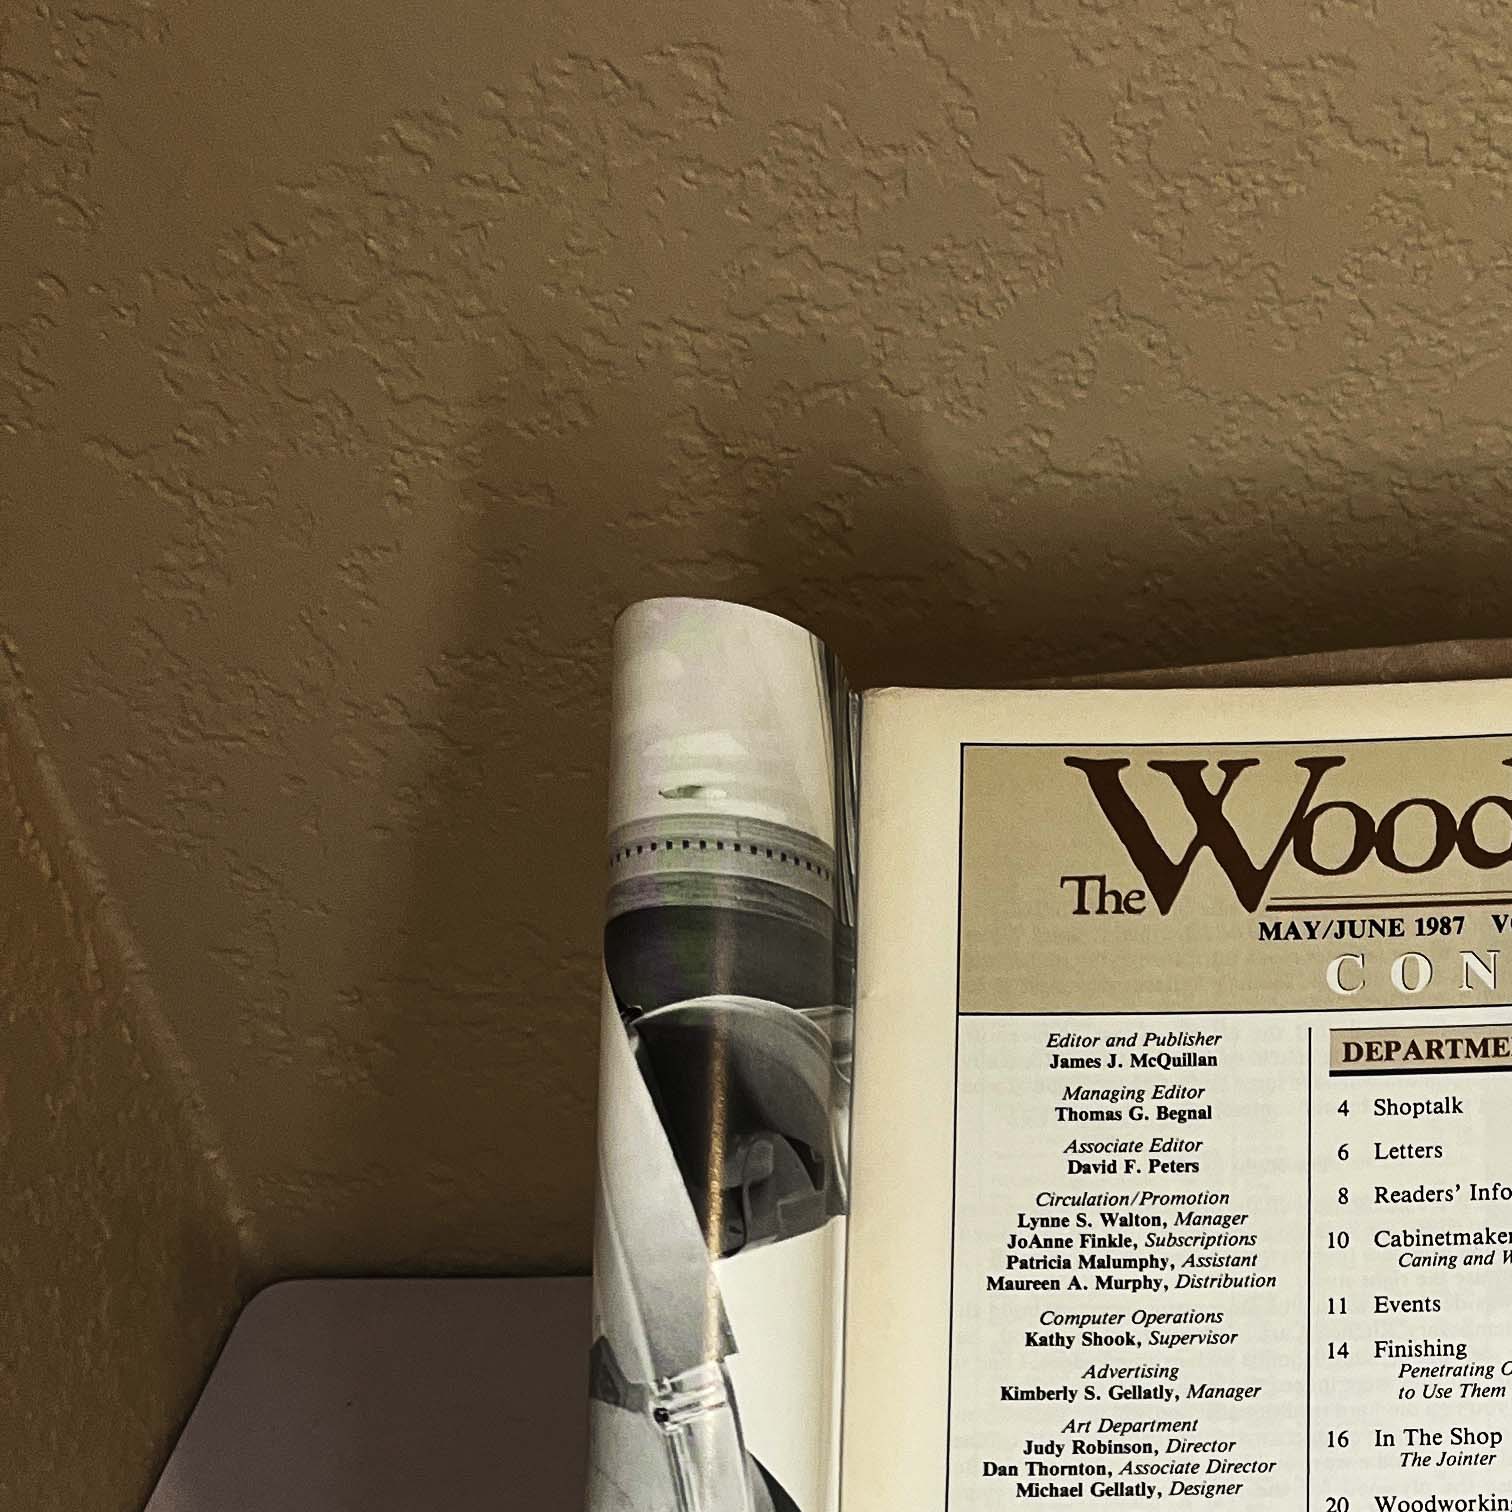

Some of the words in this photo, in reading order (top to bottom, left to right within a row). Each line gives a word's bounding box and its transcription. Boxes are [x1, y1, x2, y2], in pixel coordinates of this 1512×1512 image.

[1060, 875, 1146, 915] The
[1257, 917, 1406, 942] MAY/JUNE
[1414, 915, 1466, 937] 1987
[1045, 1032, 1102, 1049] Editor
[1105, 1031, 1139, 1048] and
[1142, 1030, 1223, 1048] Publisher
[1048, 1053, 1102, 1070] James
[1106, 1053, 1124, 1069] J.
[1129, 1051, 1219, 1071] McQuillan
[1061, 1085, 1146, 1104] Managing
[1150, 1083, 1207, 1100] Editor
[1053, 1106, 1123, 1123] Thomas
[1128, 1105, 1150, 1122] G.
[1155, 1104, 1213, 1125] Begnal
[1336, 1099, 1350, 1118] 4
[1373, 1095, 1464, 1120] Shoptalk
[1337, 1142, 1350, 1162] 6
[1373, 1141, 1444, 1161] Letters
[1337, 1186, 1349, 1206] 8
[1373, 1183, 1461, 1205] Readers'
[1016, 1212, 1071, 1232] Lynne
[1075, 1212, 1093, 1229] S.
[1098, 1211, 1168, 1230] Walton,
[1172, 1210, 1250, 1230] Manager
[1327, 1230, 1350, 1250] 10
[1398, 1251, 1459, 1270] Caning
[1462, 1249, 1496, 1267] and
[1327, 1296, 1348, 1315] 11
[1373, 1295, 1442, 1314] Events
[1327, 1341, 1350, 1360] 14
[1373, 1337, 1468, 1361] Finishing
[1080, 1362, 1180, 1382] Advertising
[1397, 1361, 1496, 1380] Penetrating
[1397, 1386, 1416, 1401] to
[1422, 1383, 1454, 1400] Use
[1459, 1382, 1507, 1399] Them
[1327, 1429, 1350, 1449] 16
[1374, 1428, 1396, 1448] In
[1402, 1427, 1443, 1447] The
[1449, 1426, 1503, 1449] Shop
[981, 1460, 1019, 1477] Dan
[1024, 1460, 1113, 1479] Thornton,
[1117, 1459, 1201, 1476] Associate
[1204, 1458, 1278, 1475] Director
[1399, 1450, 1432, 1468] The
[1435, 1450, 1498, 1467] Jointer
